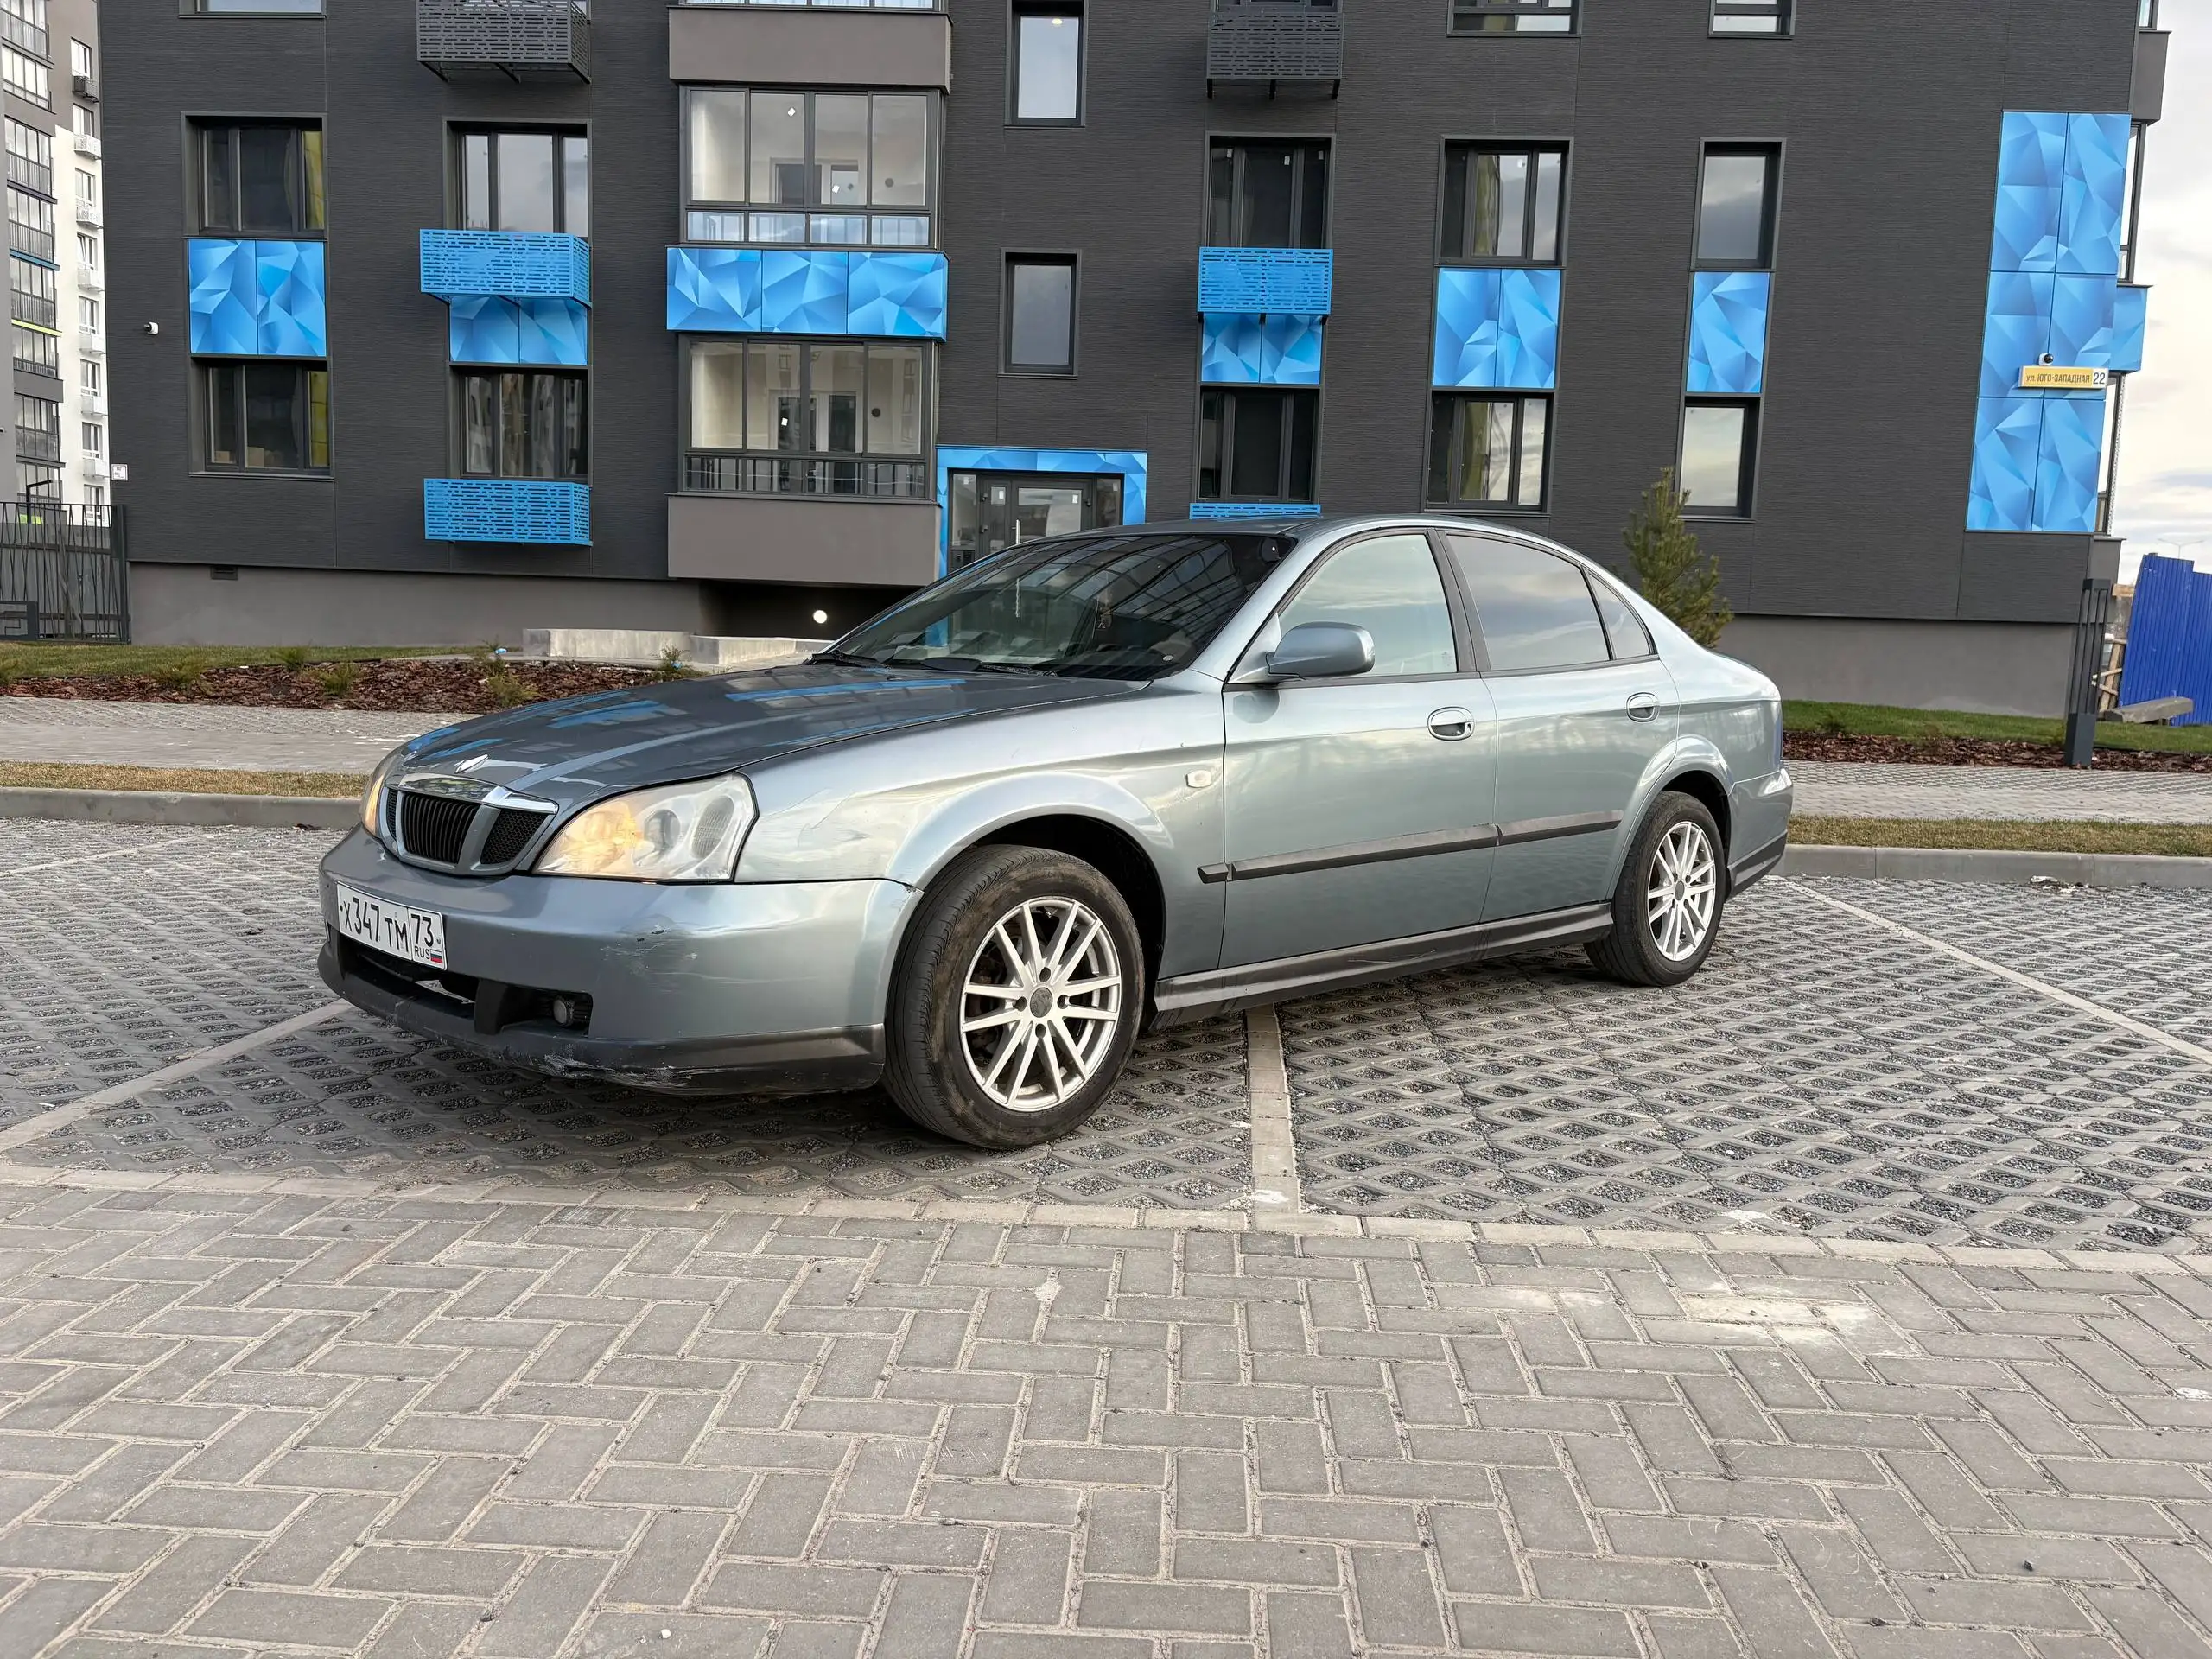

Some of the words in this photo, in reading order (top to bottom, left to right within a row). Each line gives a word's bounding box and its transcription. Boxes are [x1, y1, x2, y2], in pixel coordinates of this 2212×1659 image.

[2037, 373, 2090, 383] ЮГО-ЗАПАДНАЯ
[2093, 372, 2106, 385] 22
[410, 913, 434, 947] 73
[414, 945, 430, 960] RUS
